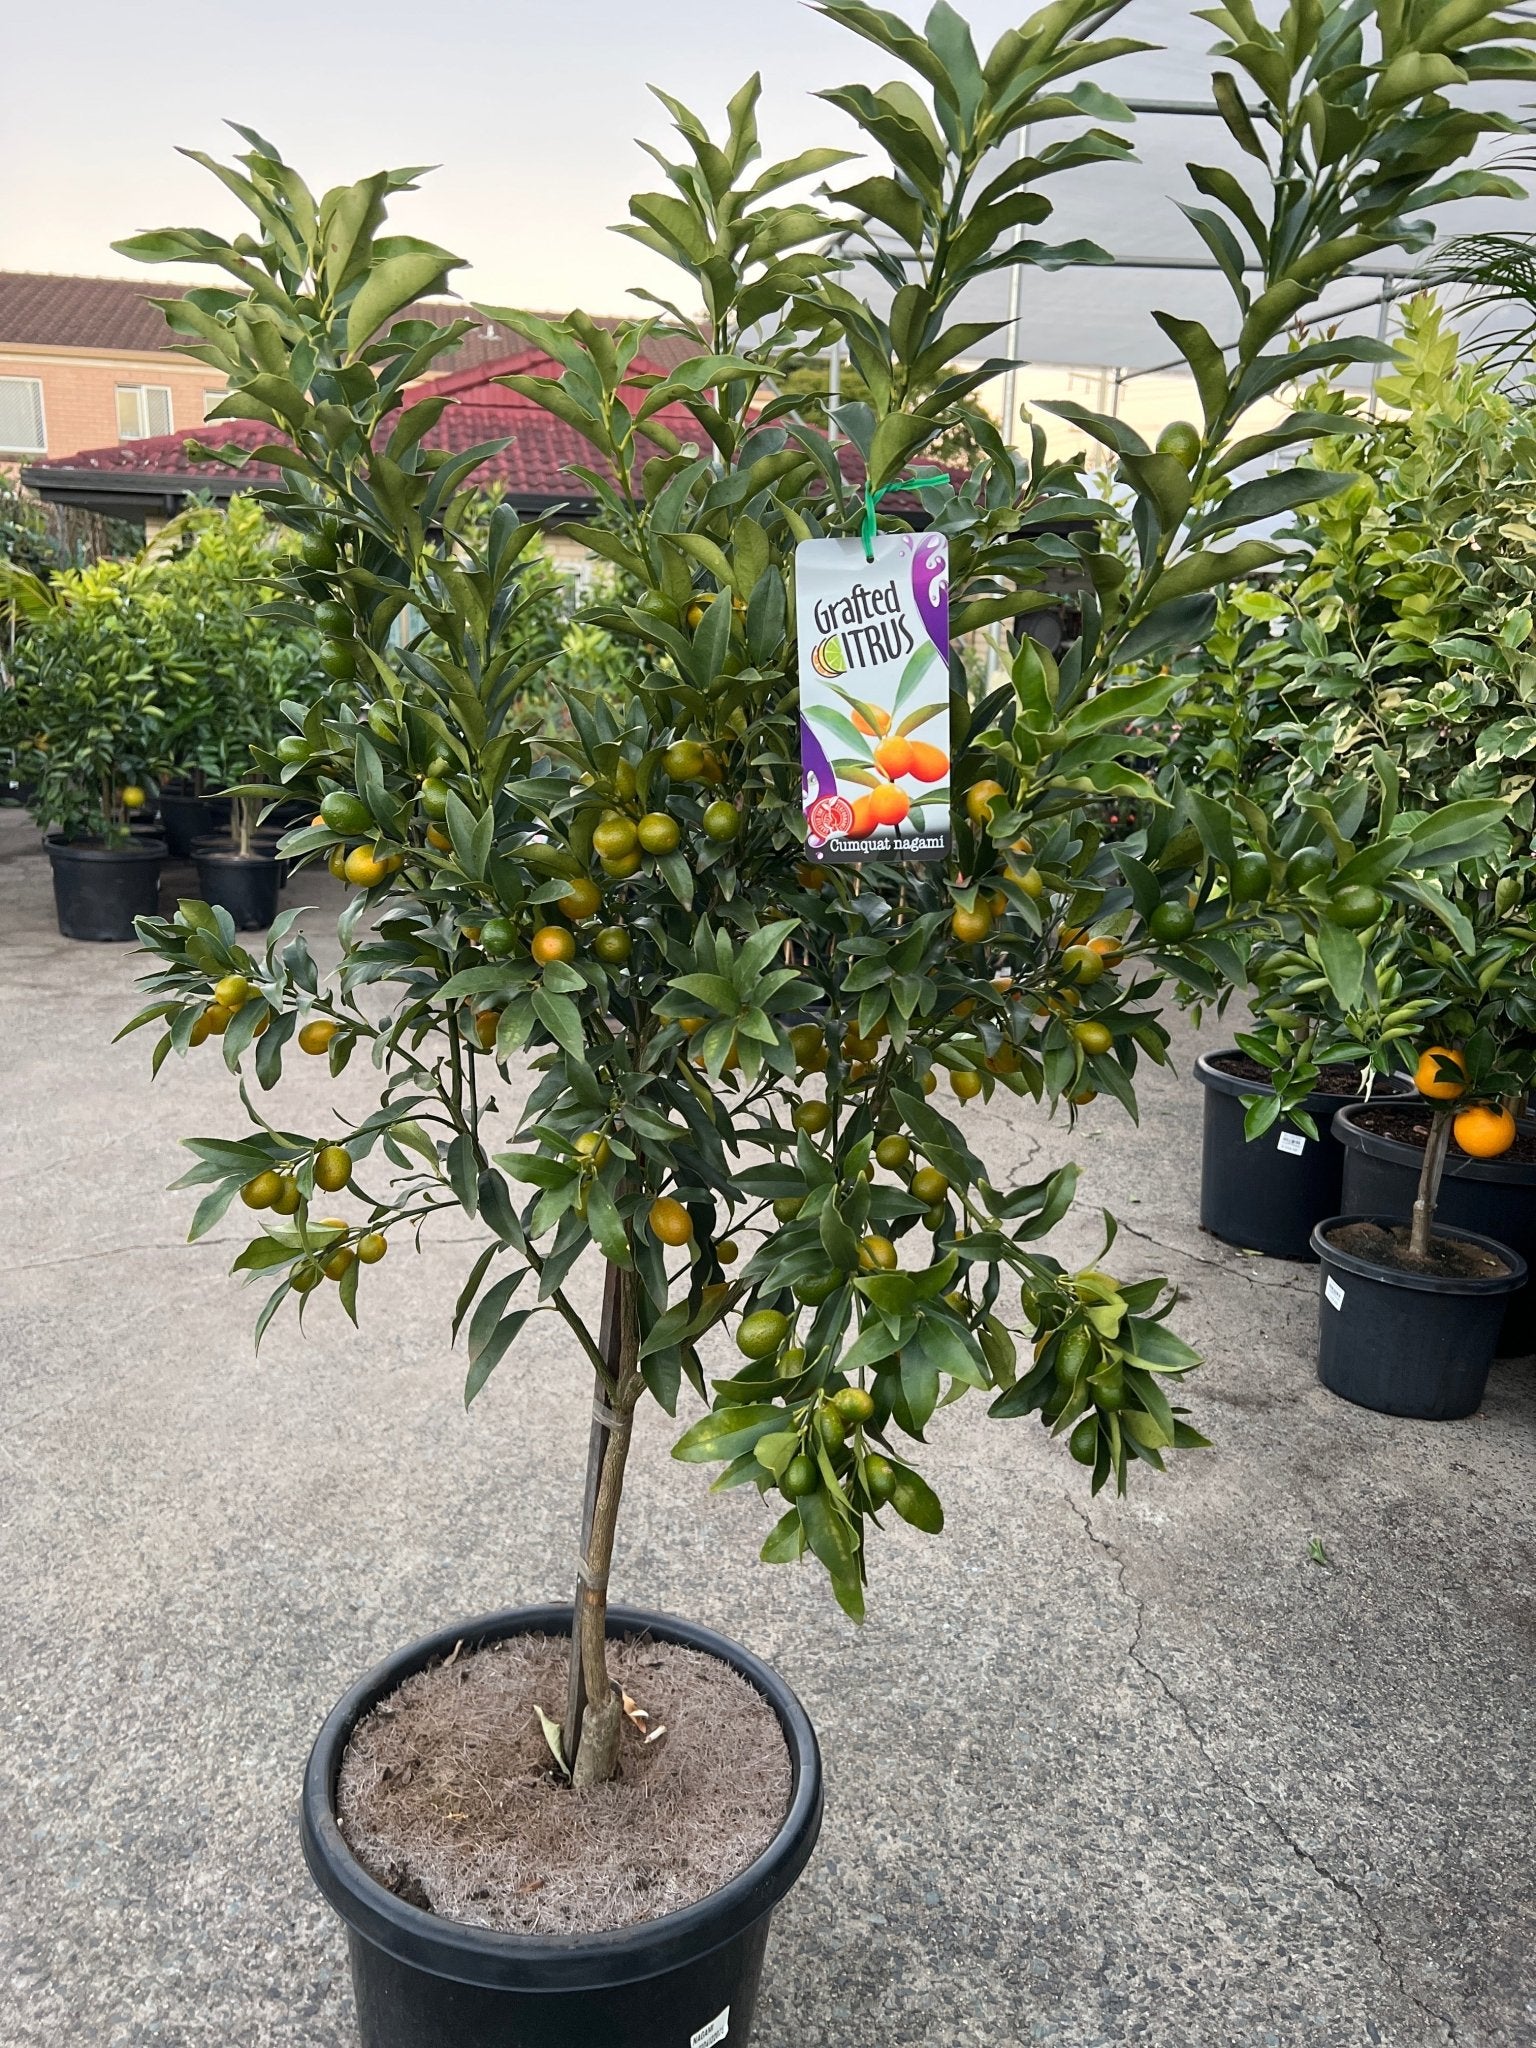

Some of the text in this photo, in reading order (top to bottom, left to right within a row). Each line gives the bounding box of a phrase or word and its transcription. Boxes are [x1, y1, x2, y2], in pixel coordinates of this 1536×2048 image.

[814, 580, 900, 634] Grafted
[830, 835, 945, 853] Cumquat nagami
